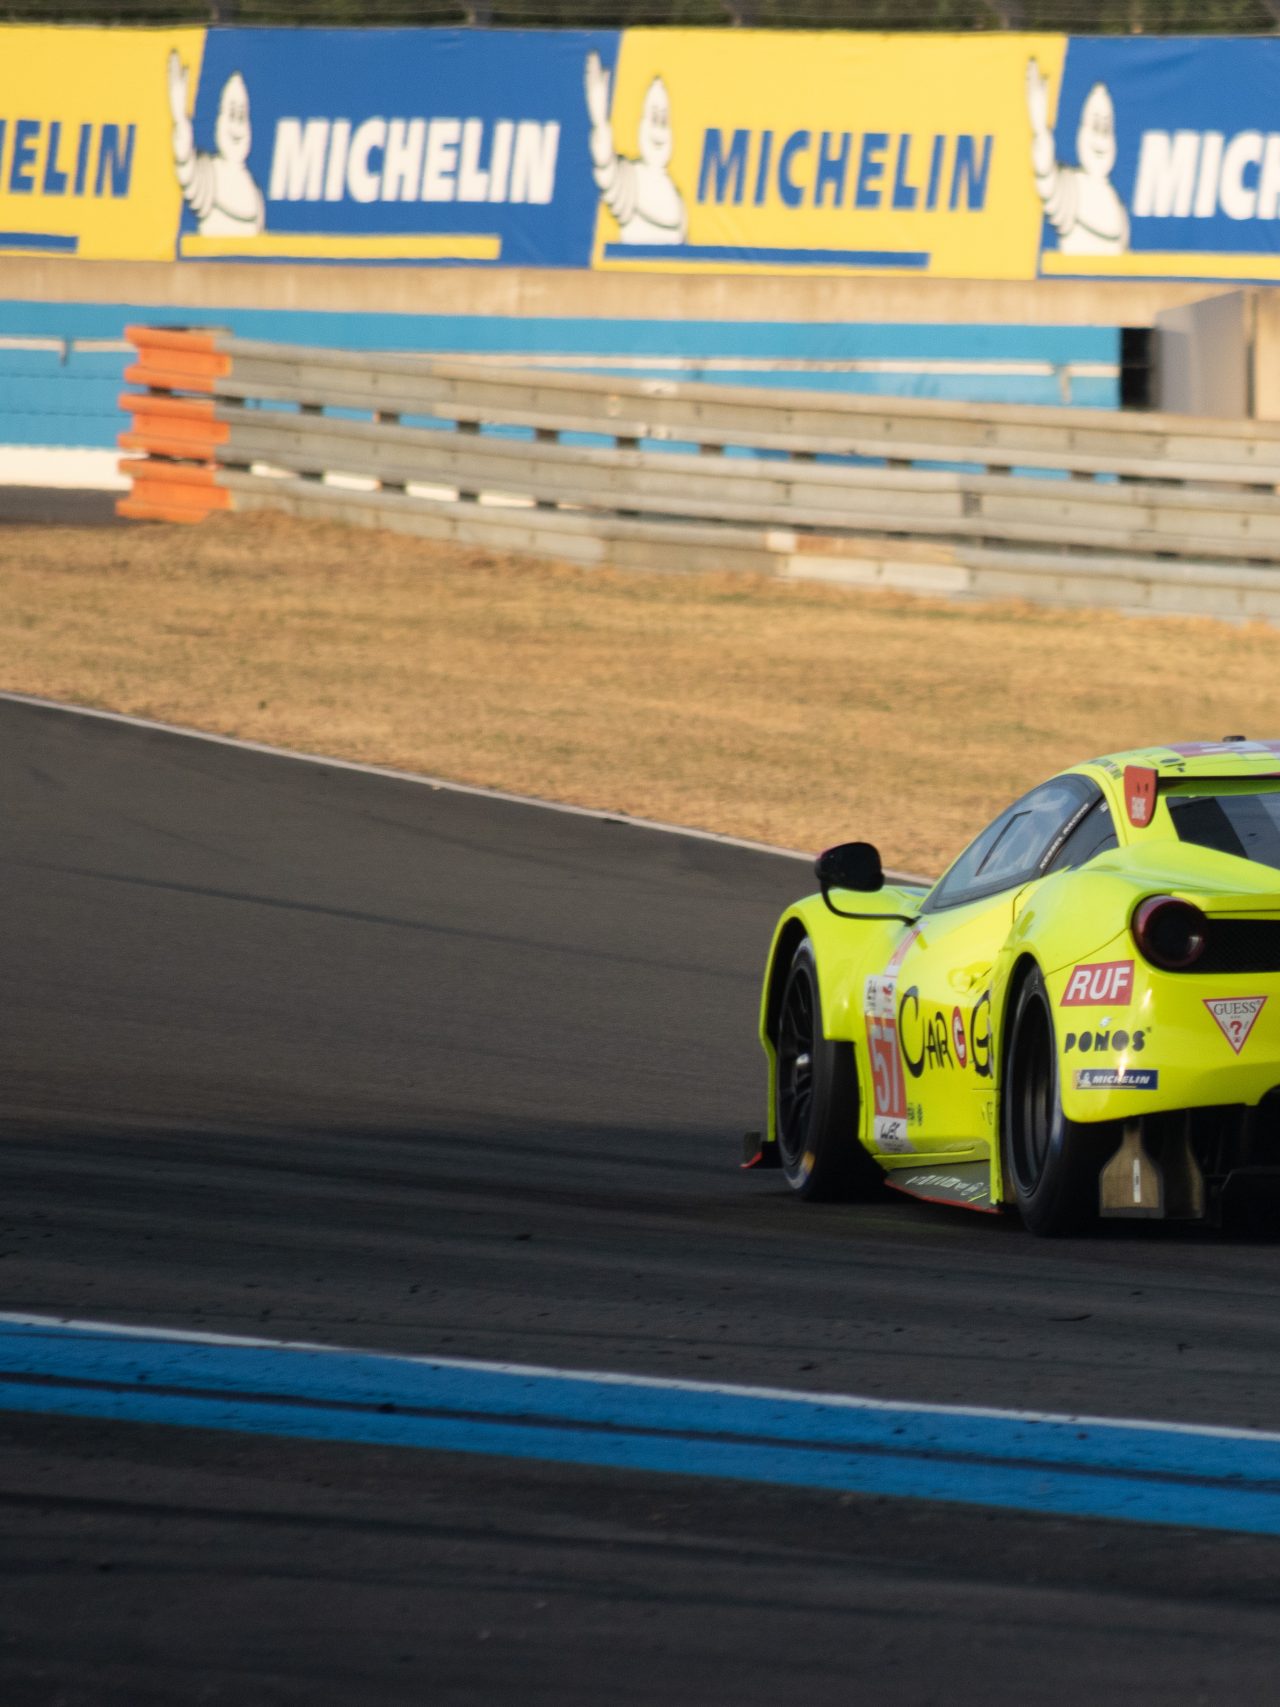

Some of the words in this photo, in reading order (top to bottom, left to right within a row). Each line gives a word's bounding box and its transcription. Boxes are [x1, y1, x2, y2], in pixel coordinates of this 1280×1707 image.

[269, 117, 560, 205] MICHELIN
[697, 127, 994, 213] MICHELIN
[1066, 966, 1131, 1001] RUF
[1213, 1002, 1257, 1016] GUESS
[1064, 1030, 1146, 1054] PONOS
[870, 1023, 900, 1113] 57
[1092, 1074, 1151, 1085] MICHELIN
